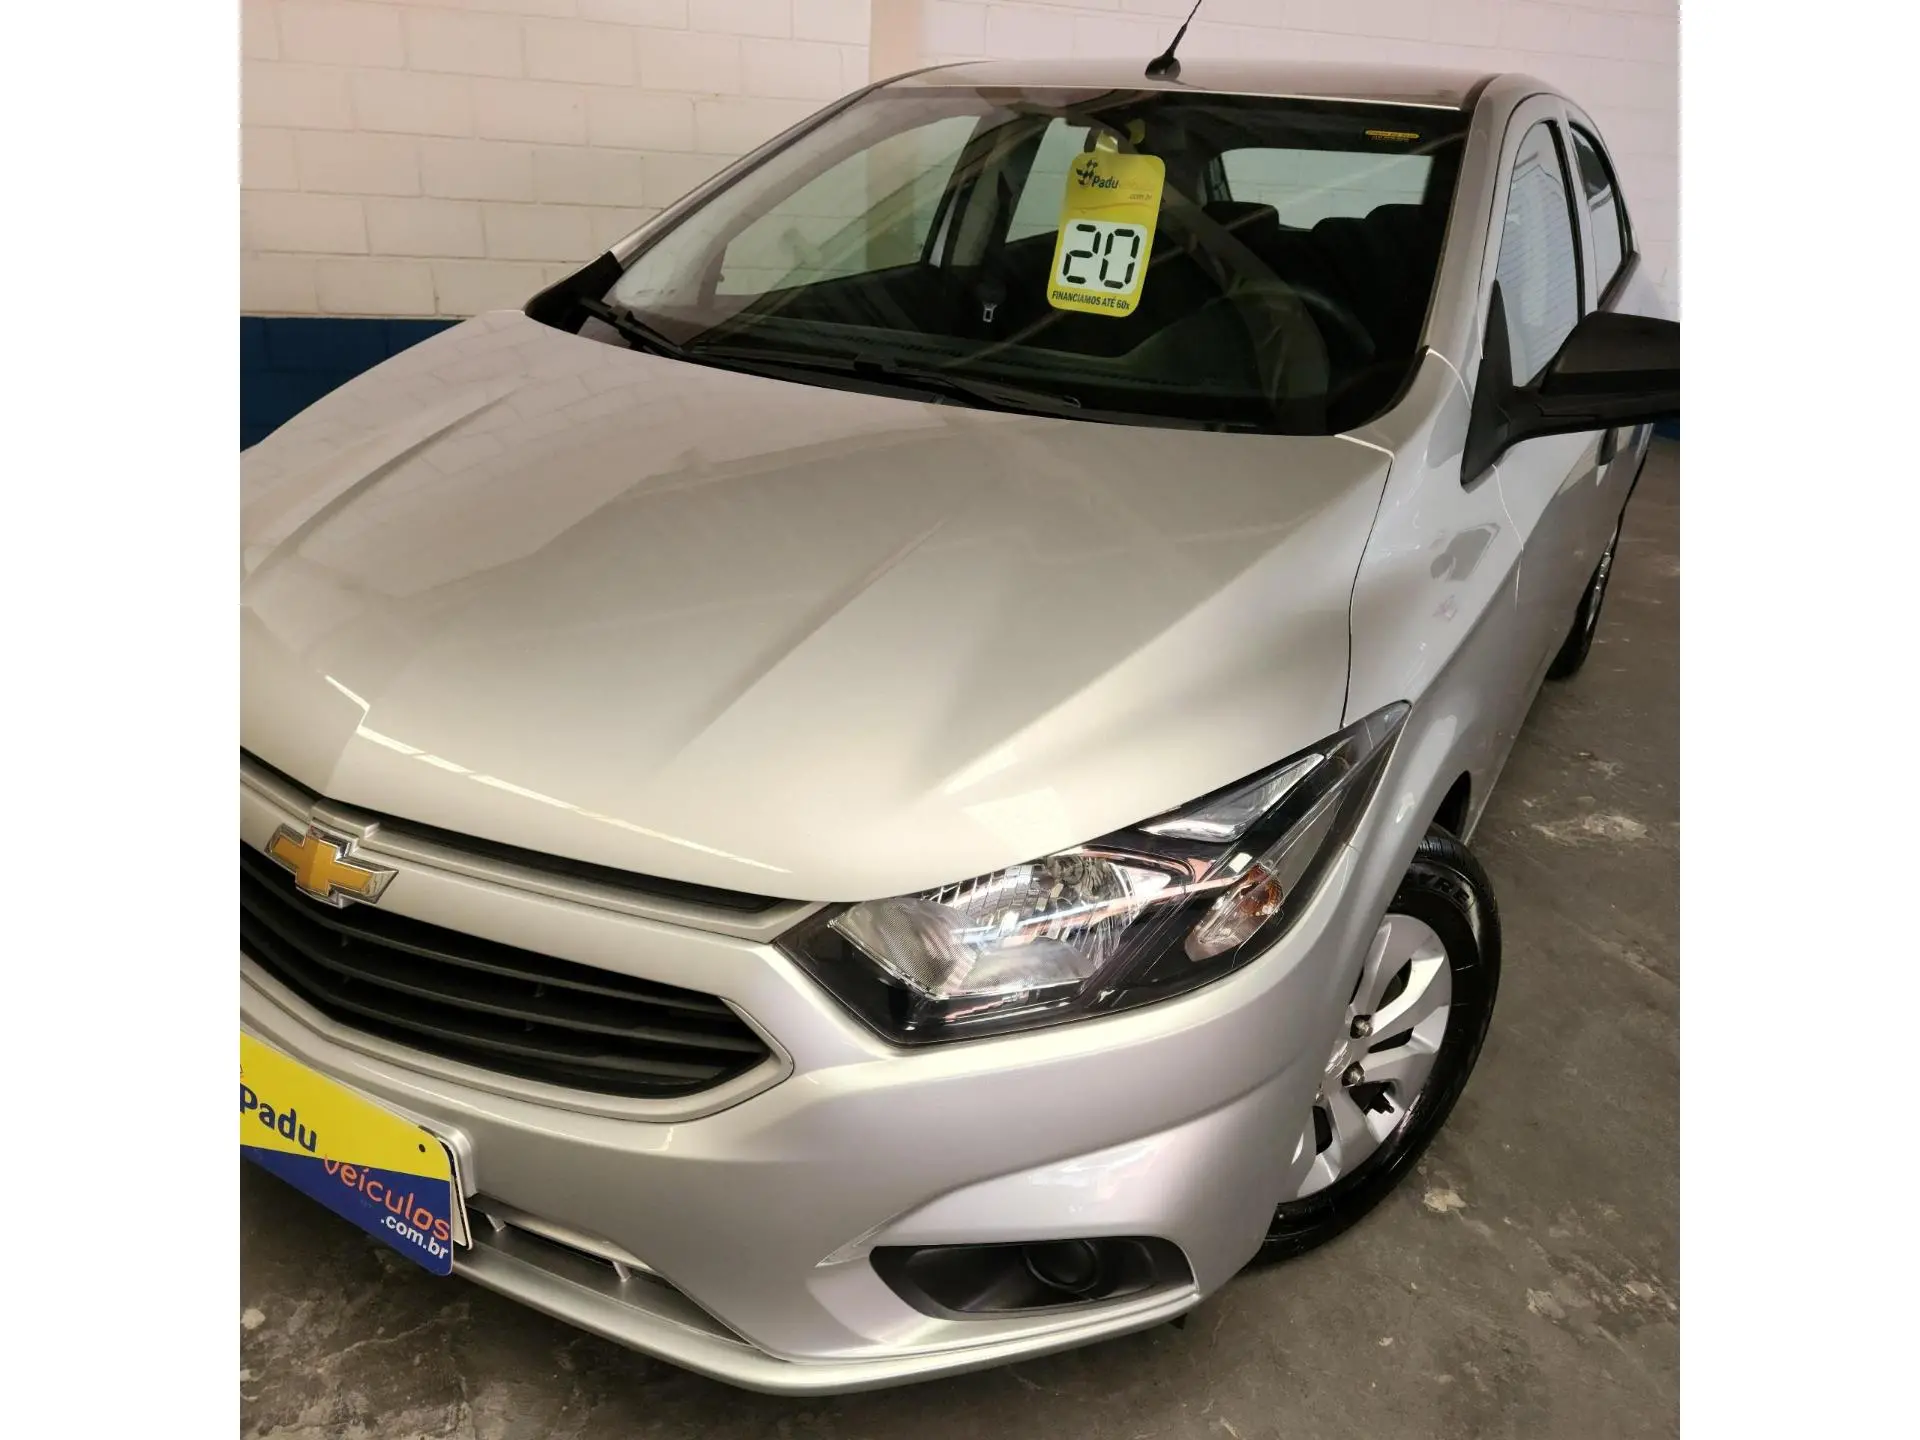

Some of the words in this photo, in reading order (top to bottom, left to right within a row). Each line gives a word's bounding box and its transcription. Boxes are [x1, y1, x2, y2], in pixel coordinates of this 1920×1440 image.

[1092, 175, 1120, 189] Padu
[1062, 223, 1141, 289] 20
[1052, 290, 1101, 306] FINANCIAMOS
[1101, 296, 1116, 307] ATÉ
[240, 1082, 317, 1153] Padu
[324, 1154, 450, 1241] veículos
[380, 1215, 449, 1259] .com.br
